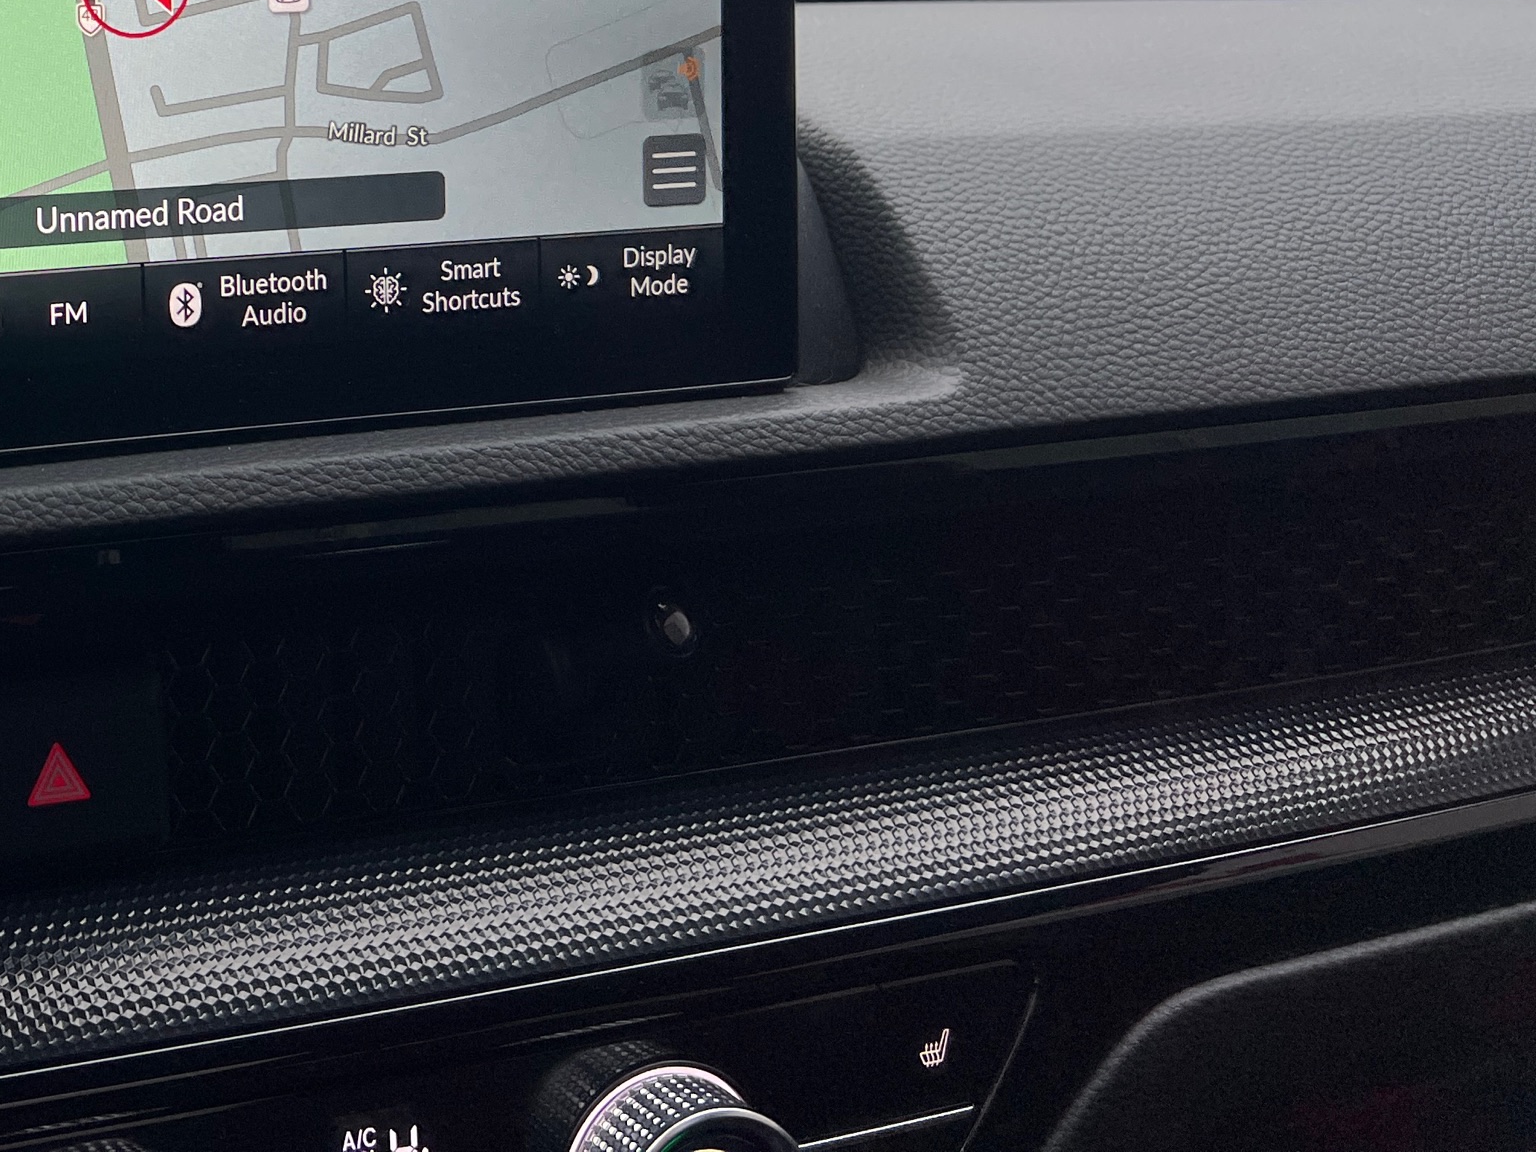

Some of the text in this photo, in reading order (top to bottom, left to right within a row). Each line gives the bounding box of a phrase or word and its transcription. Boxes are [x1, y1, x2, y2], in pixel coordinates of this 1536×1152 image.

[328, 121, 428, 146] Millard St
[36, 194, 244, 235] Unnamed Road
[440, 256, 502, 281] Smart
[623, 243, 696, 272] Display
[220, 268, 327, 298] Bluetooth
[630, 272, 689, 298] Mode
[422, 286, 521, 313] Shortcuts
[50, 301, 88, 326] FM
[241, 301, 307, 327] Audio
[342, 1127, 377, 1152] A/C
